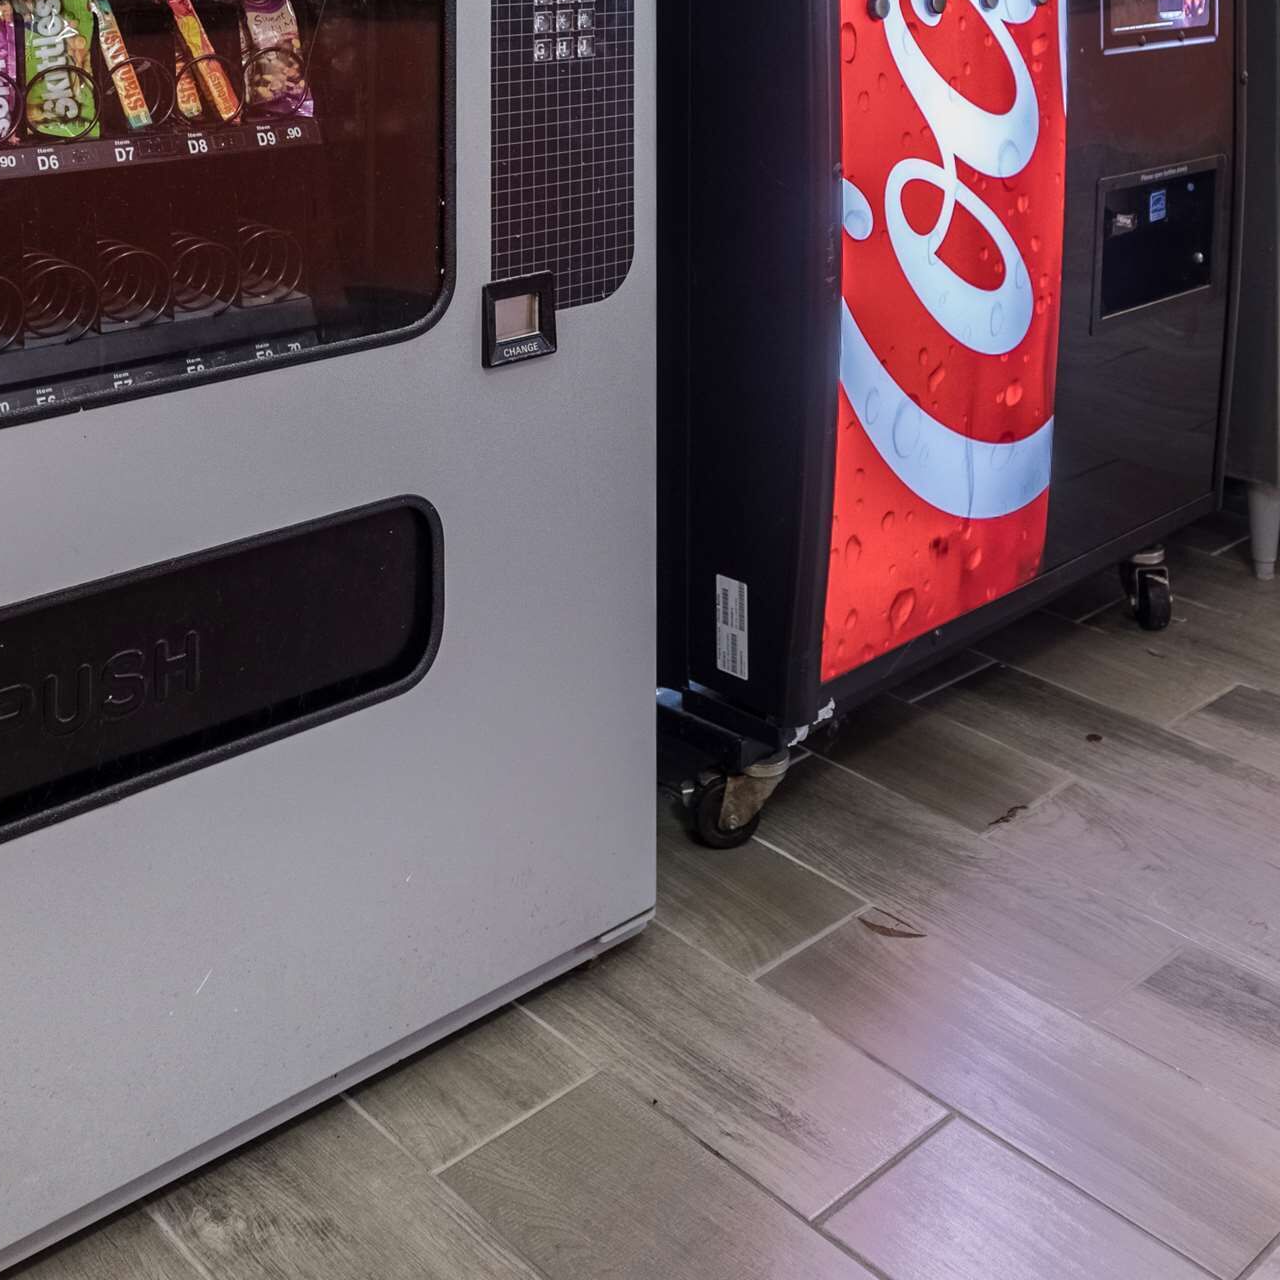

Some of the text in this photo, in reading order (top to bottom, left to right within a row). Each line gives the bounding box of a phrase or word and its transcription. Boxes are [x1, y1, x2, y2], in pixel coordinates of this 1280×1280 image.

[256, 131, 277, 146] D9
[285, 127, 302, 140] .90
[187, 139, 208, 154] D8
[37, 154, 59, 171] D6
[115, 147, 135, 163] D7
[504, 342, 539, 357] CHANGE
[113, 371, 129, 379] Item
[36, 387, 53, 395] Item
